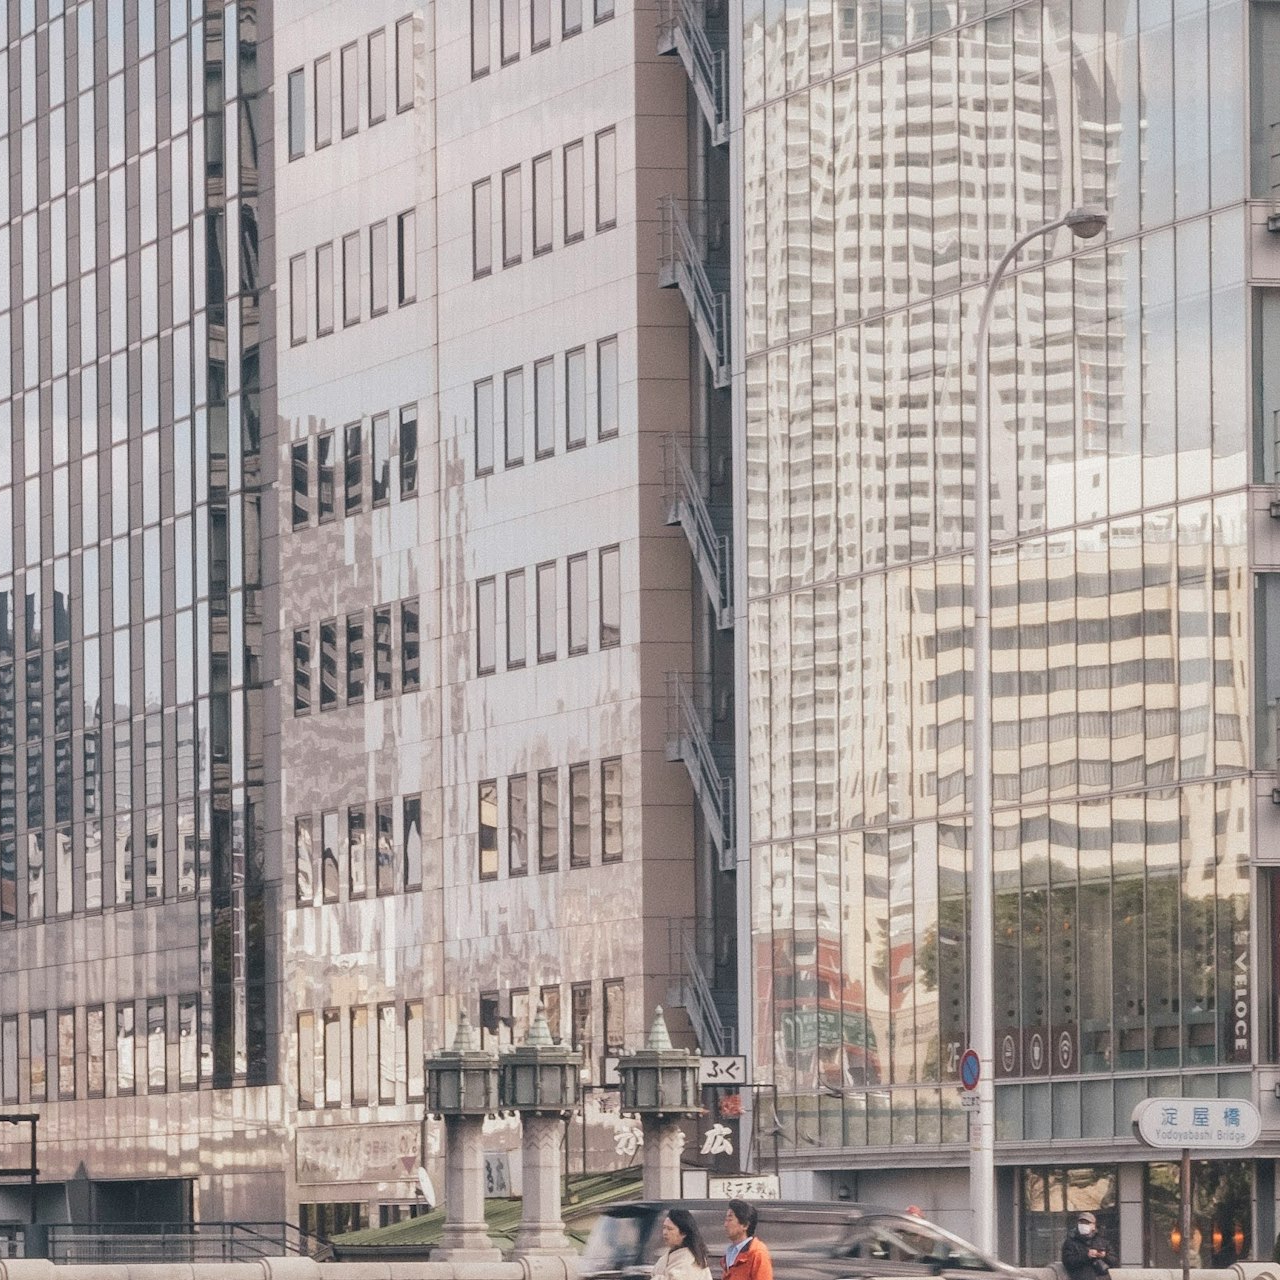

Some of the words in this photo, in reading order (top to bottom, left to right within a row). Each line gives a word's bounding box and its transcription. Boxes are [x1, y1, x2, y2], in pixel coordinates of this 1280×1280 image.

[1234, 952, 1248, 1050] VELOCE
[947, 1042, 960, 1073] 2F
[706, 1060, 740, 1080] ふぐ
[1161, 1107, 1240, 1127] 淀屋橋
[1156, 1130, 1212, 1142] Yodoyabashi
[1217, 1130, 1245, 1143] Bridge
